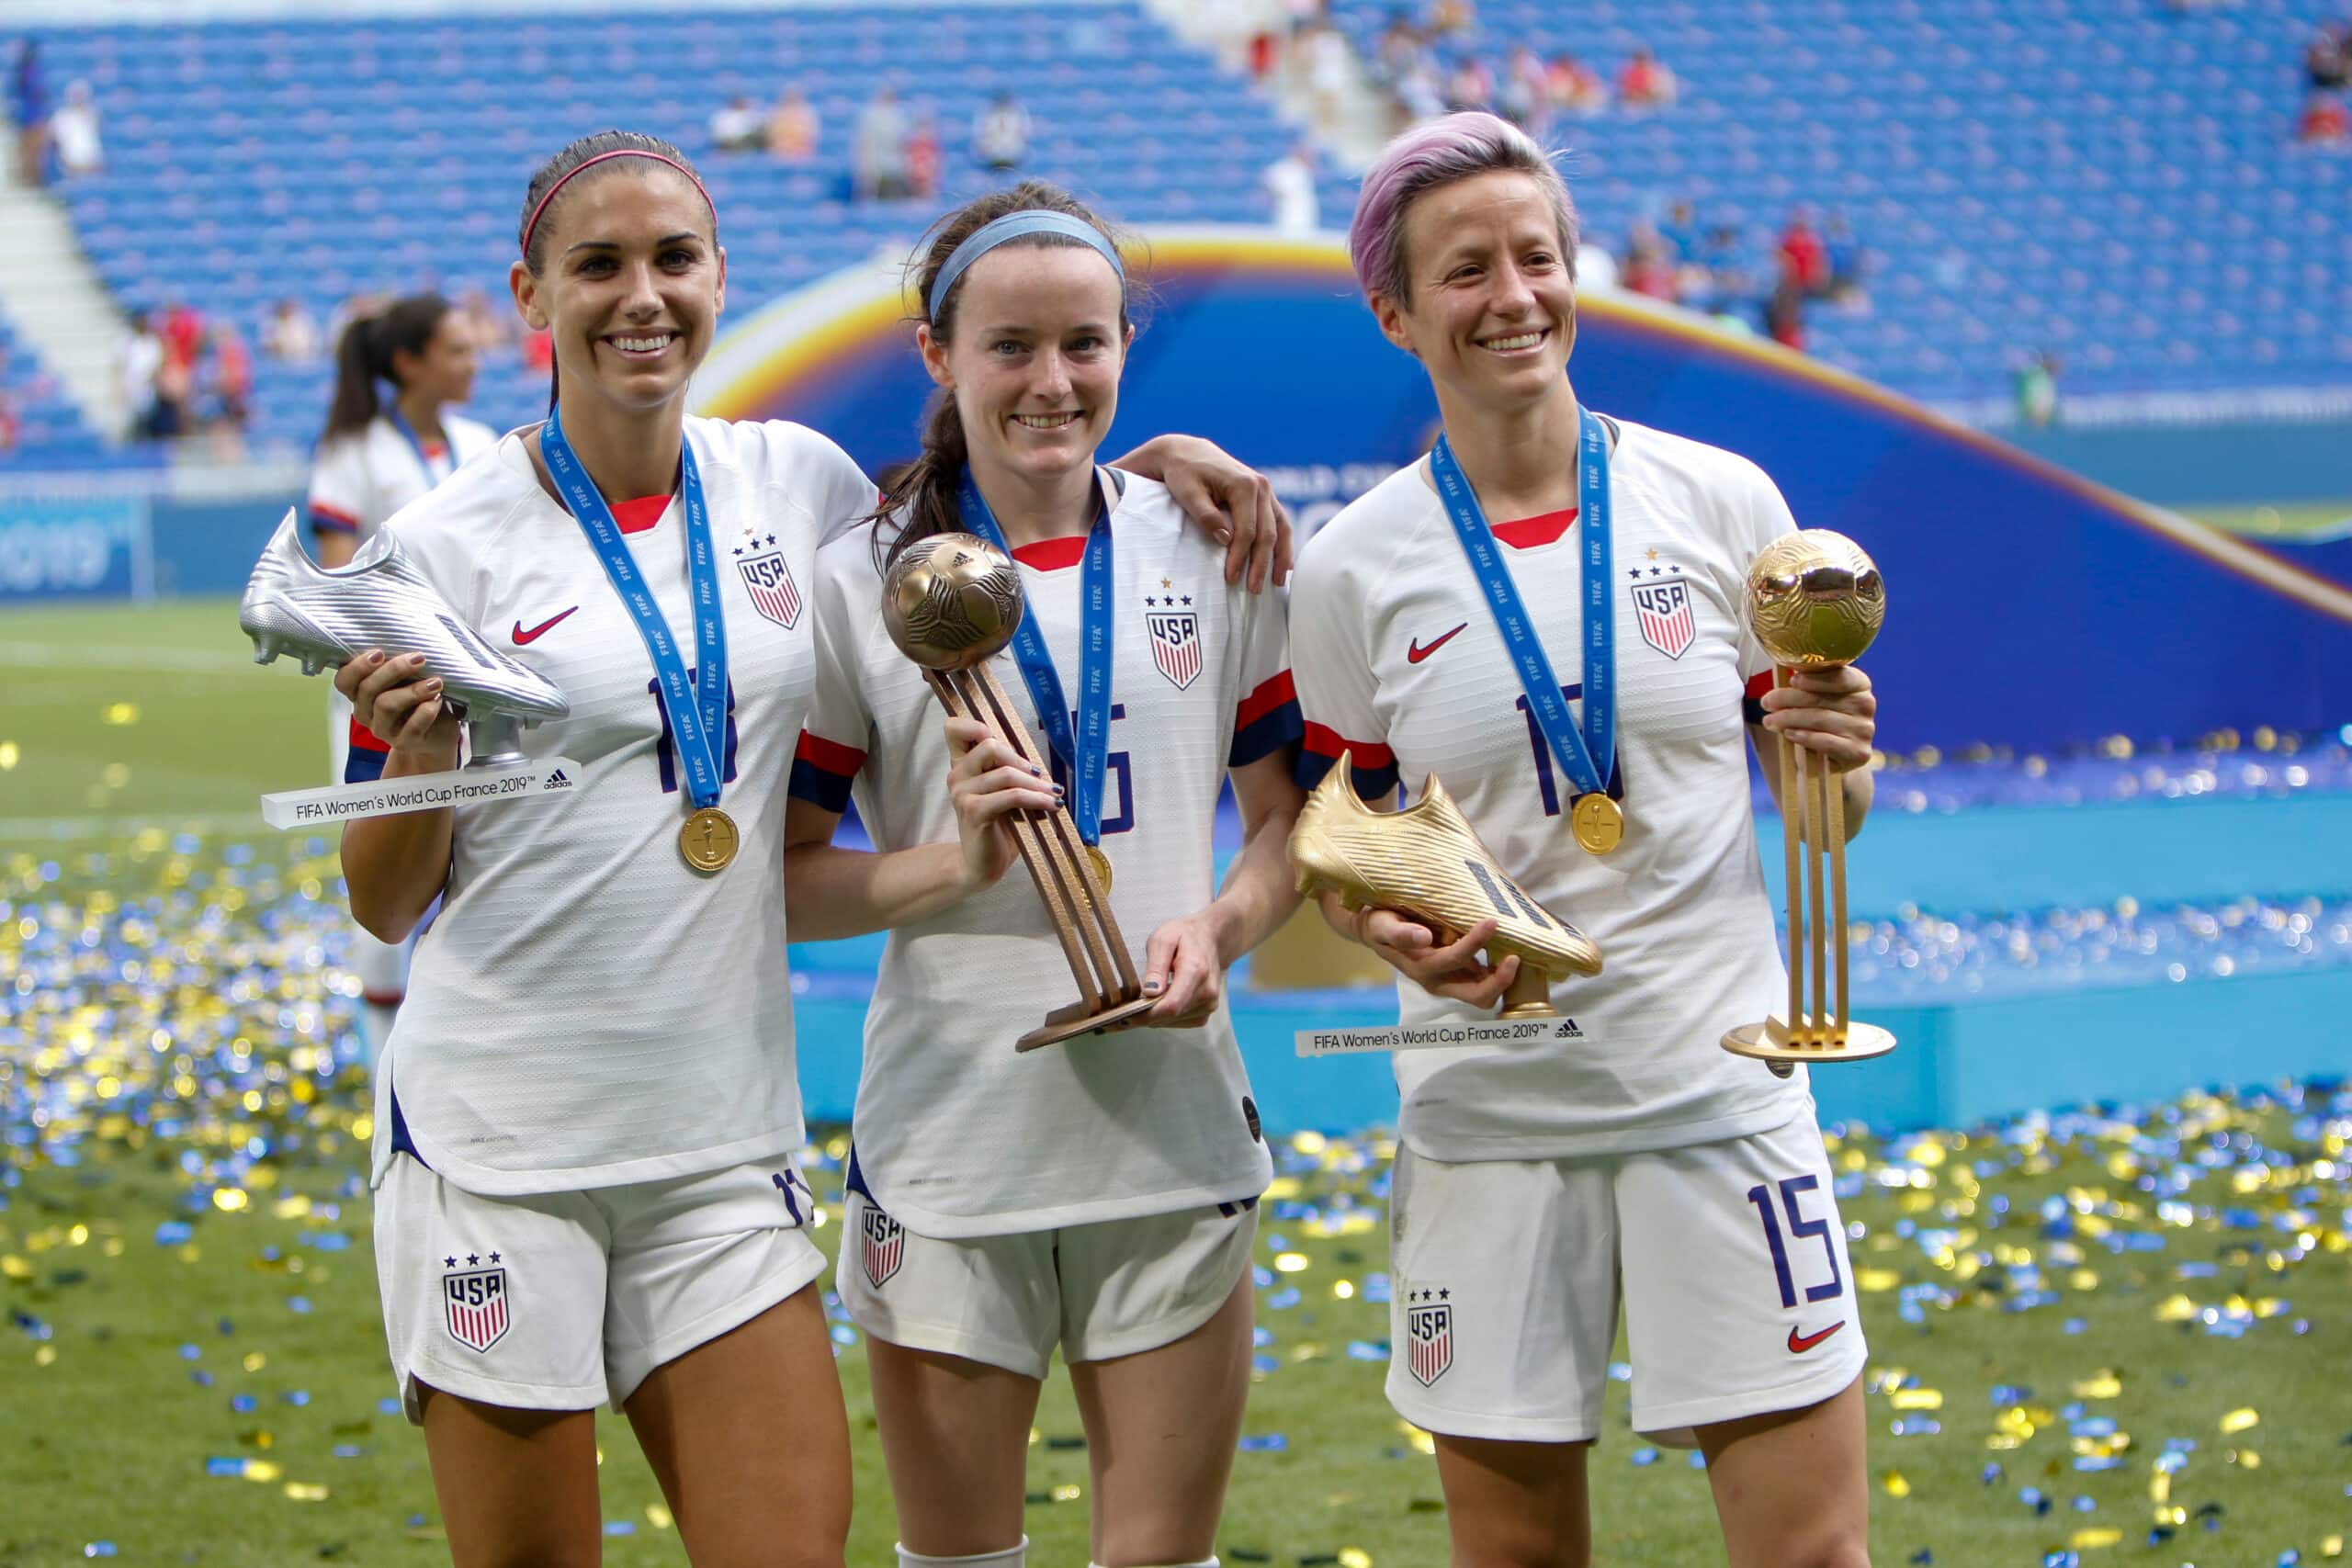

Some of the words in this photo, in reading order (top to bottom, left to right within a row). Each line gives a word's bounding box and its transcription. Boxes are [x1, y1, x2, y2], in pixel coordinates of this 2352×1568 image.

[743, 558, 785, 588] USA
[1637, 586, 1684, 615] USA
[1151, 618, 1193, 646] USA
[544, 780, 573, 791] adidas
[296, 803, 323, 819] FIFA
[325, 795, 384, 816] Women's
[386, 790, 423, 807] World
[425, 788, 452, 803] Cup
[454, 783, 498, 799] France
[1314, 1035, 1340, 1049] FIFA
[1342, 1031, 1399, 1048] Women's
[1401, 1029, 1437, 1044] World
[1439, 1028, 1465, 1043] Cup
[1467, 1027, 1510, 1041] France
[1747, 1174, 1844, 1308] 15
[449, 1273, 501, 1307] USA
[1410, 1309, 1446, 1341] USA
